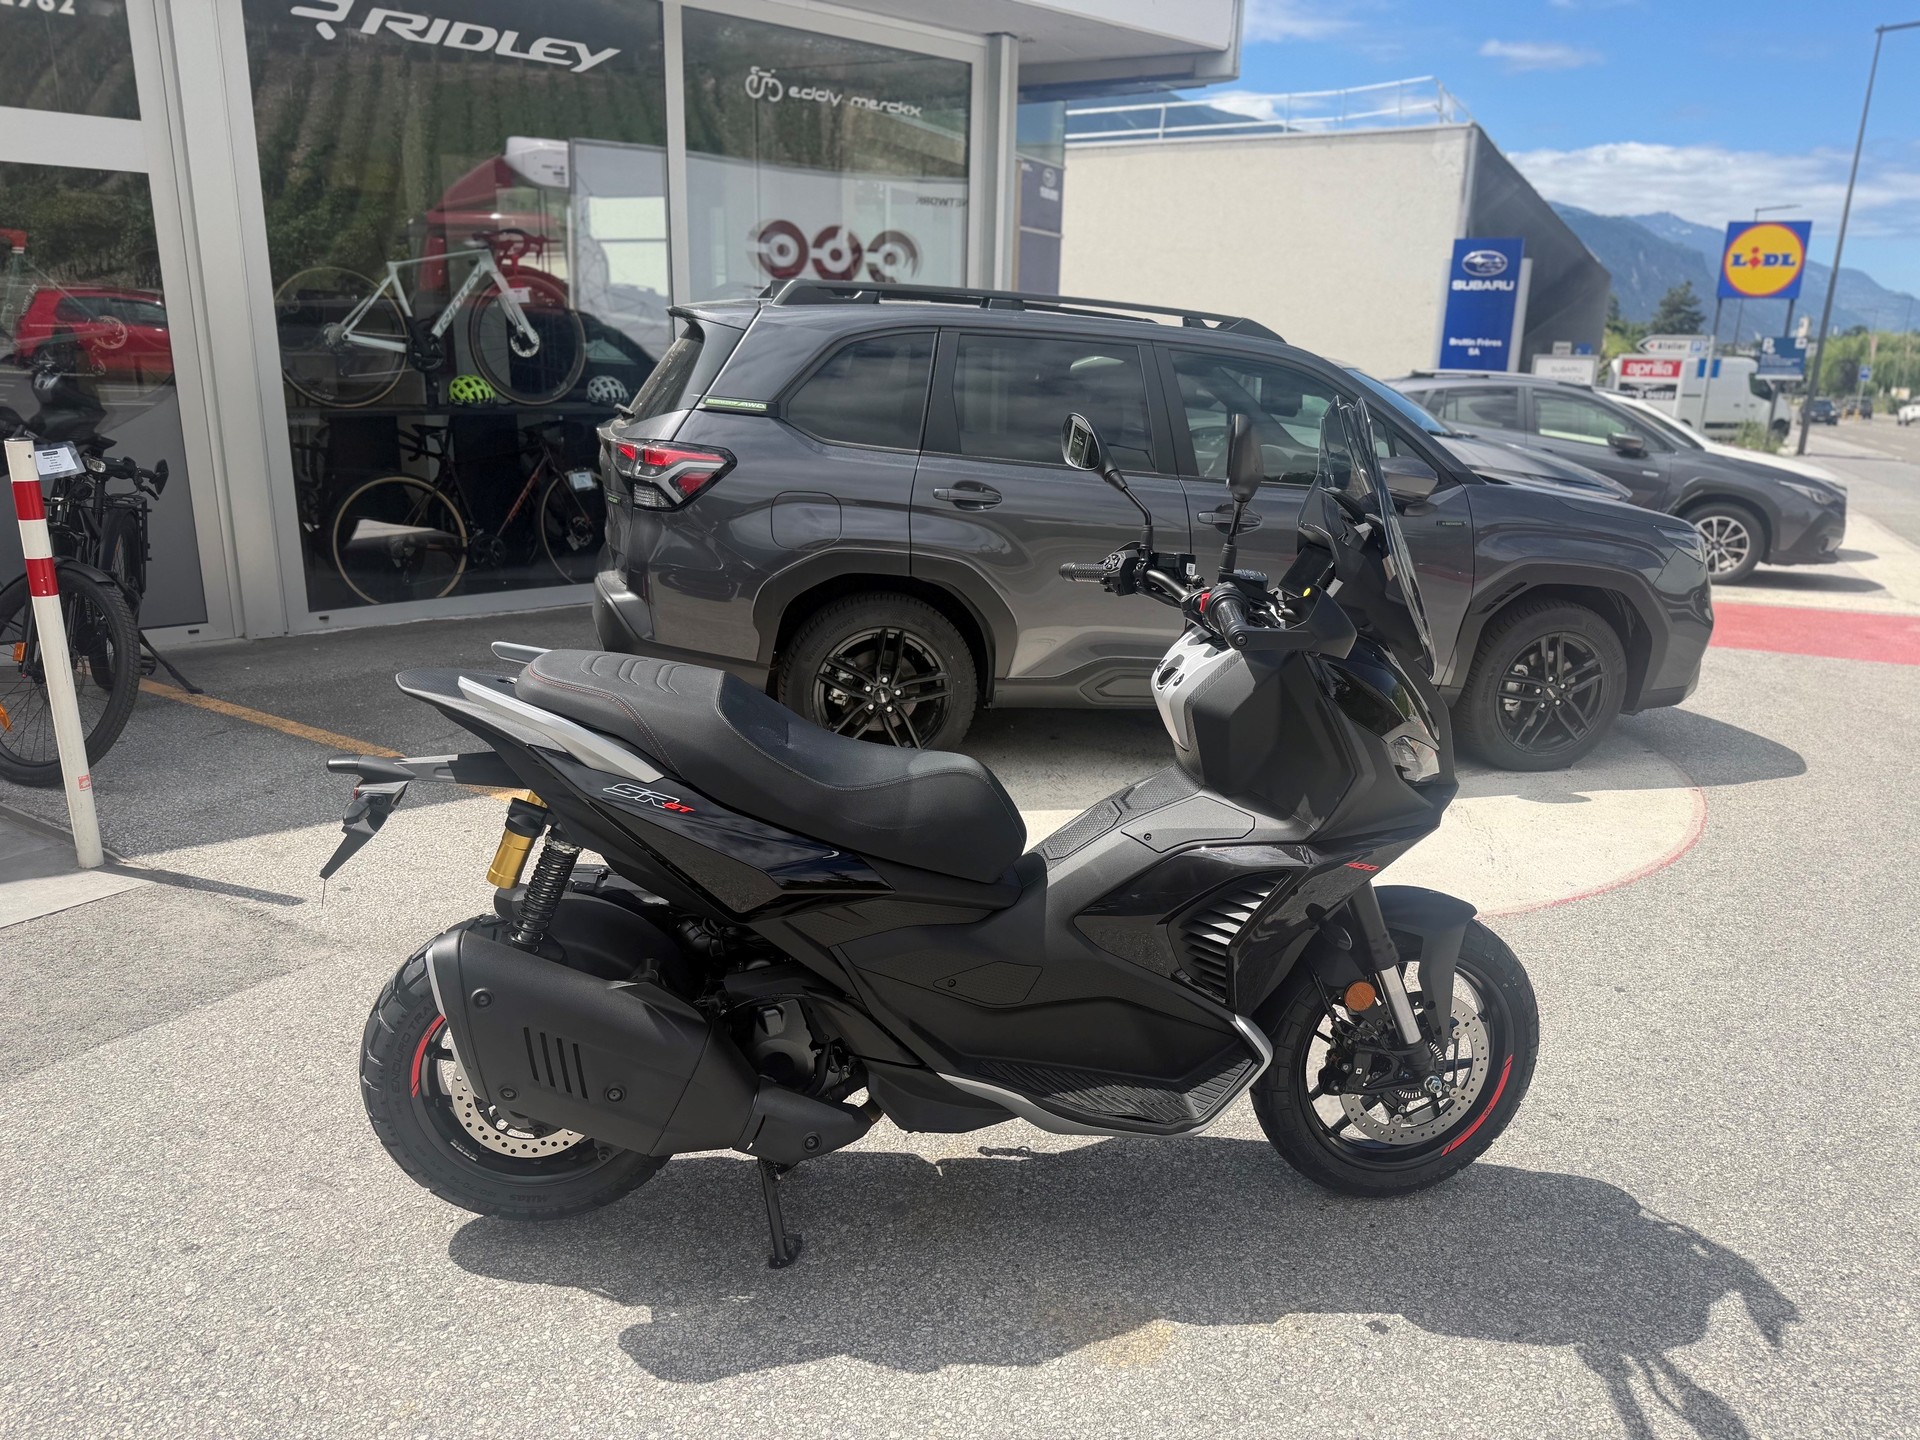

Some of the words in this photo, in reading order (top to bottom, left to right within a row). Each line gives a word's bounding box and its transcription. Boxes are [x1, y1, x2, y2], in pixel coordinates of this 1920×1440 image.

[360, 7, 621, 73] RIDLEY
[788, 86, 843, 107] eddy
[850, 96, 922, 117] merckx
[1452, 280, 1515, 291] SUBARU
[1626, 360, 1674, 376] aprilia
[1344, 862, 1379, 872] 400
[391, 1032, 412, 1093] ENDURO
